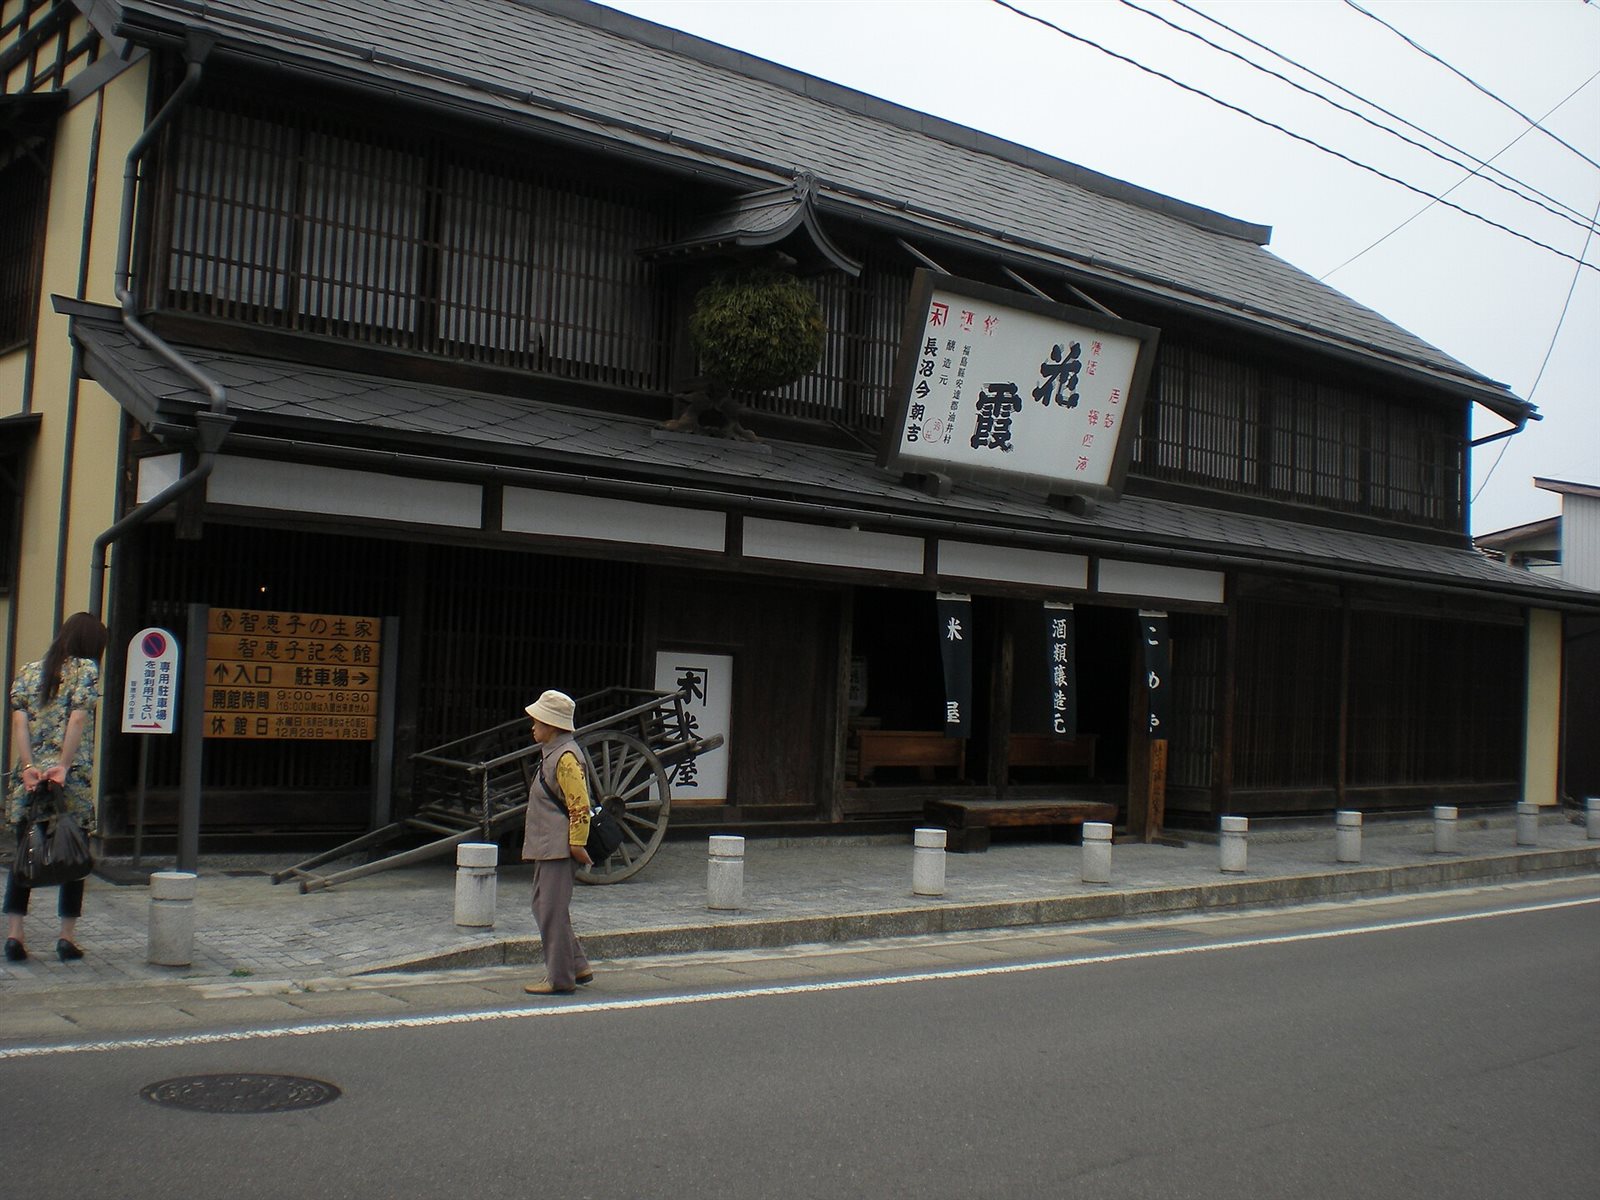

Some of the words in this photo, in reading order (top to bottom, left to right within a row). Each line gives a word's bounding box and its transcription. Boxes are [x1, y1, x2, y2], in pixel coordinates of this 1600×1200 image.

[907, 336, 939, 443] 長沼今朝吉
[239, 612, 373, 638] 智恵子の生家
[237, 637, 373, 664] 智恵子記念館
[233, 664, 273, 685] 入口
[295, 667, 349, 687] 駐車場
[140, 660, 157, 720] を御利用下さい
[155, 661, 171, 721] 専用駐車場
[211, 689, 270, 710] 開館時間
[211, 716, 269, 737] 休館日
